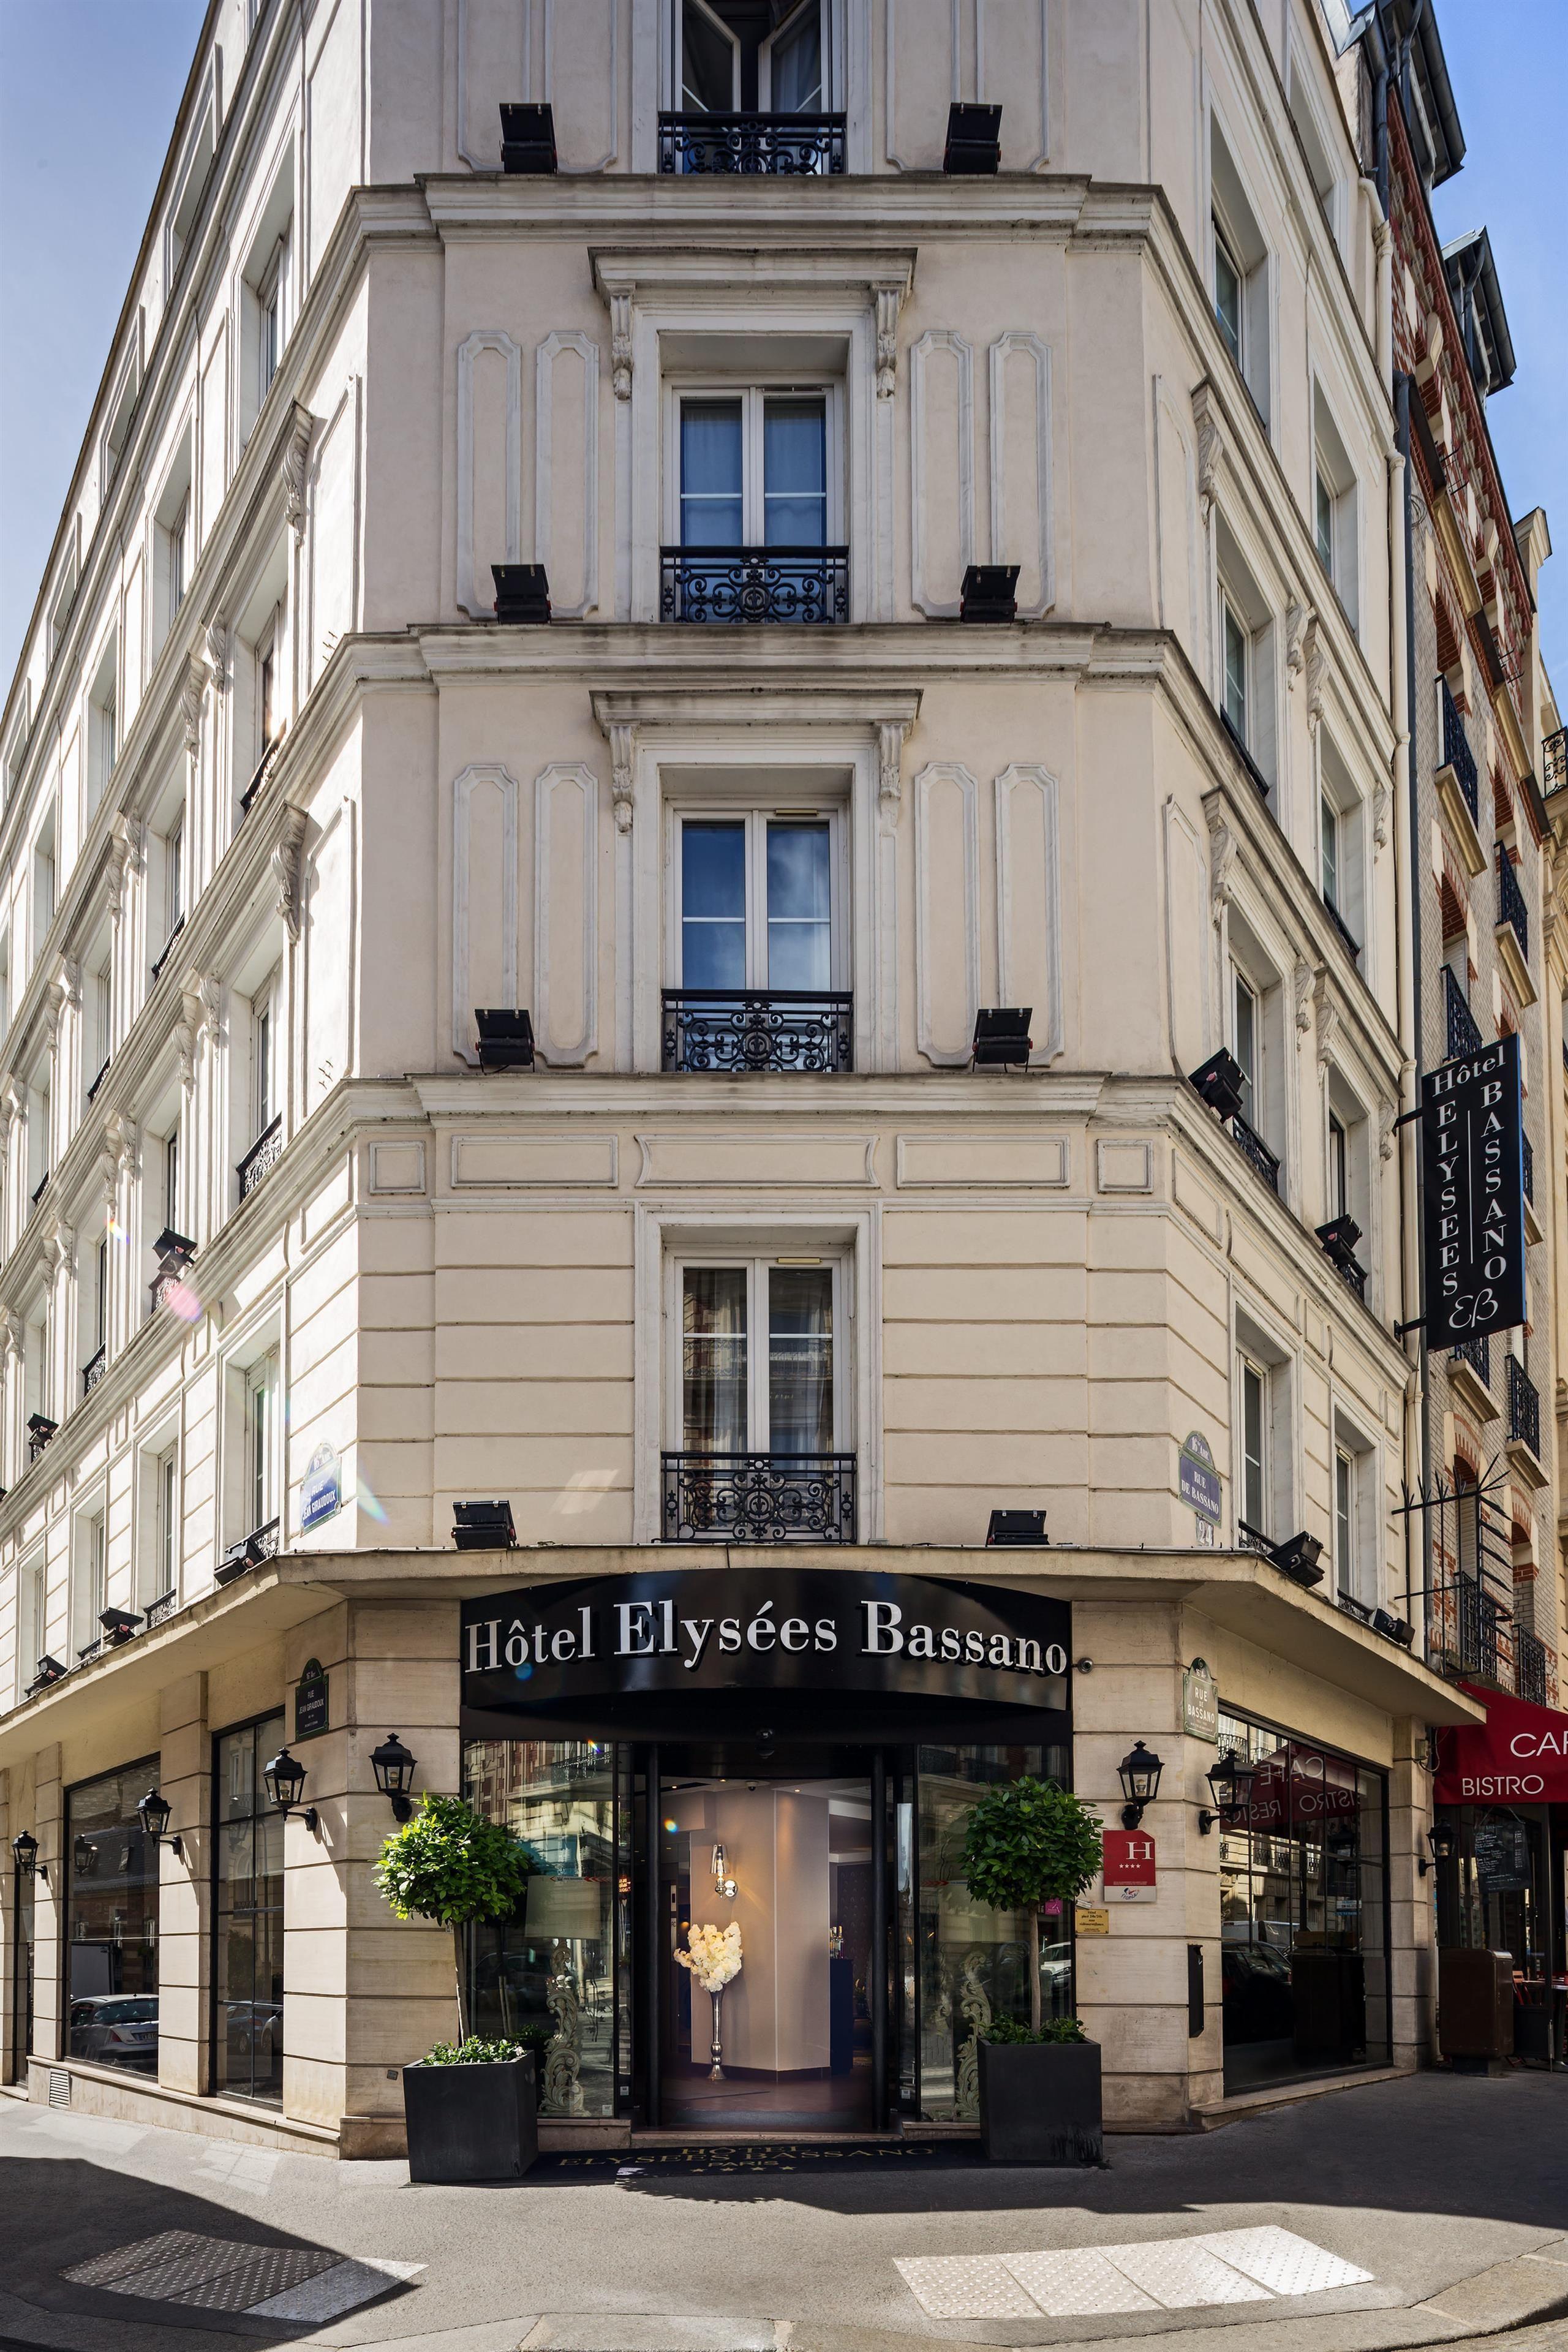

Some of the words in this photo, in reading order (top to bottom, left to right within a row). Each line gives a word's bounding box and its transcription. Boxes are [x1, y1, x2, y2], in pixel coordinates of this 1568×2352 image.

[1431, 1045, 1506, 1098] Hôtel
[1436, 1099, 1460, 1297] ELYSEES
[1480, 1080, 1507, 1280] BASSANO
[311, 1480, 324, 1496] RUE
[1194, 1471, 1206, 1489] RUE
[303, 1504, 311, 1520] JEAN
[311, 1489, 336, 1513] GIRAUDOUX
[1182, 1479, 1190, 1494] DE
[1192, 1487, 1219, 1515] BASSANO
[1199, 1520, 1212, 1546] 24
[465, 1606, 595, 1673] Hôtel
[613, 1599, 837, 1668] Elysées
[861, 1600, 1067, 1674] Bassano
[1195, 1686, 1207, 1702] RUE
[307, 1698, 324, 1712] GIRAUDOUX
[1188, 1704, 1215, 1724] BASSANO
[1462, 1775, 1544, 1796] BISTRO
[1125, 1842, 1154, 1860] H
[742, 2148, 933, 2160] BASSANO
